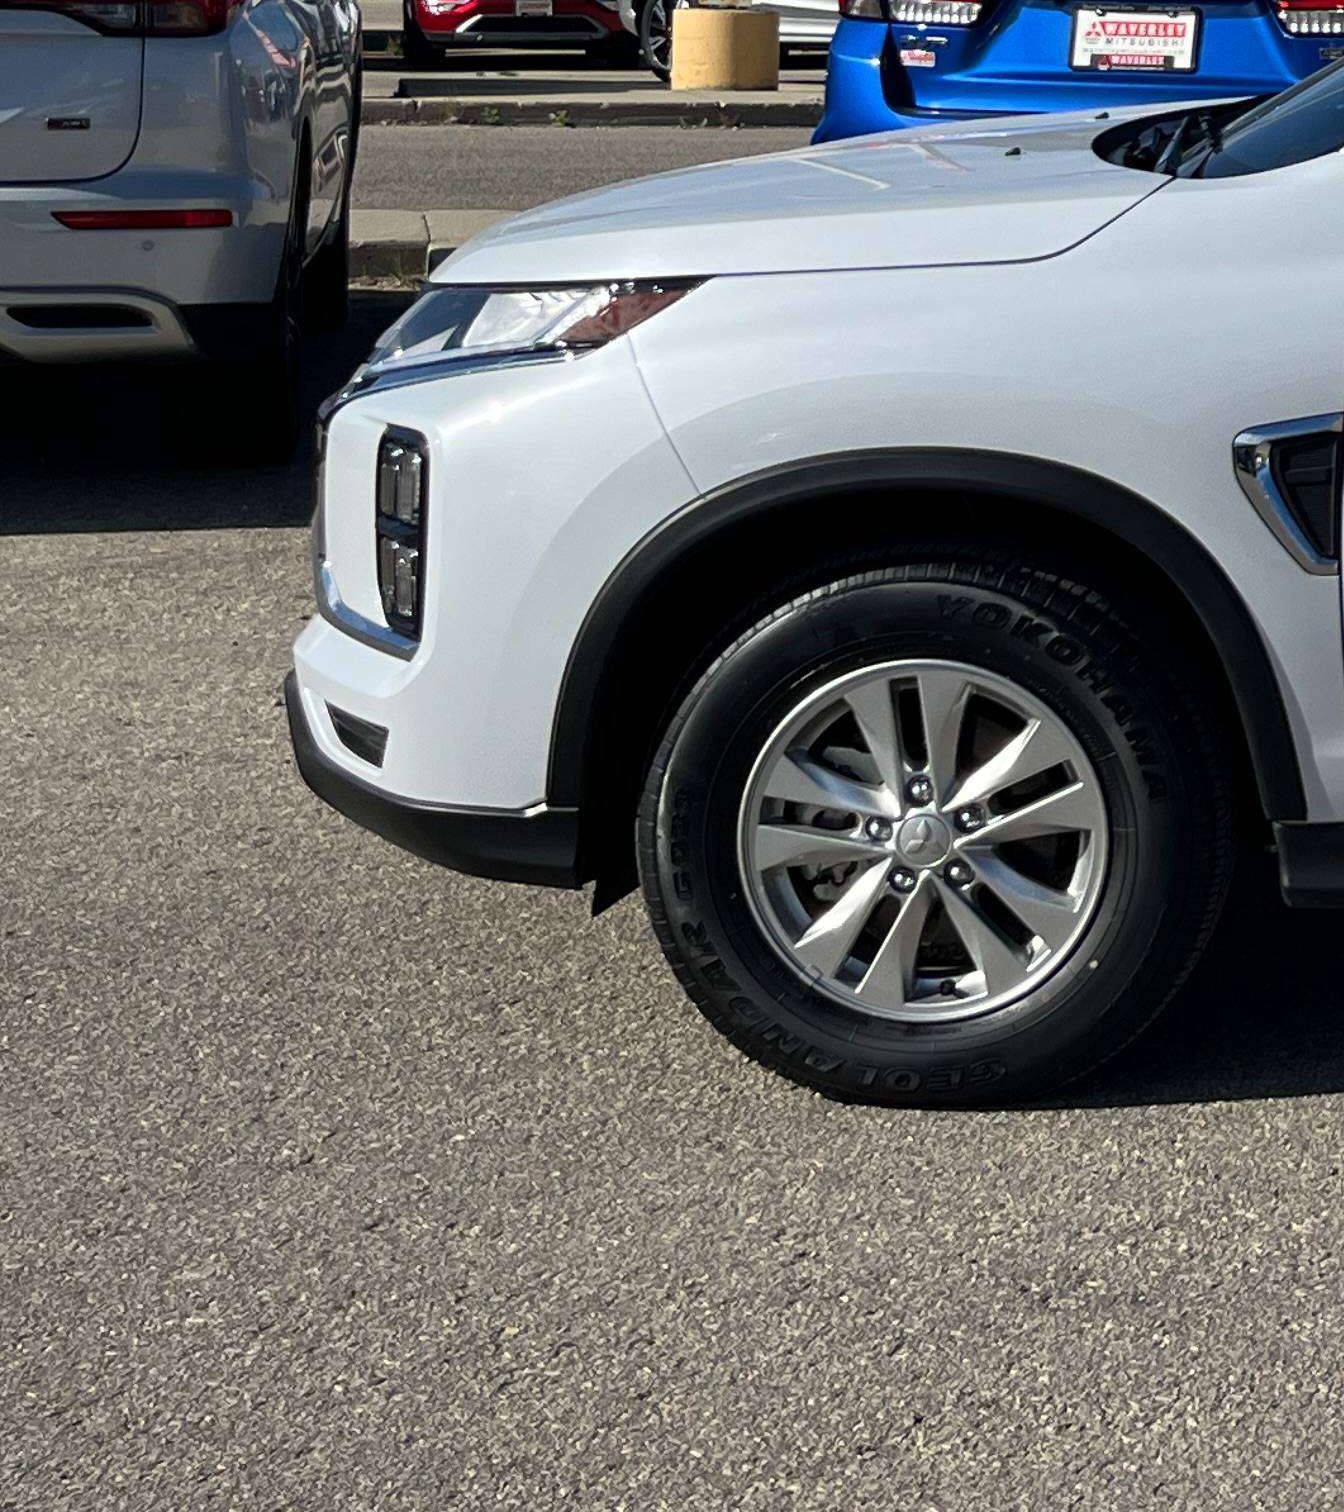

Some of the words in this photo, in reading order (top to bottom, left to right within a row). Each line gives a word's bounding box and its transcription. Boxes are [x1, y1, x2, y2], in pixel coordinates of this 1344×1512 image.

[1104, 23, 1185, 37] WAVERLEY
[938, 594, 1168, 802] YOKOHAMA
[681, 922, 1007, 1094] GEOLANDAR
